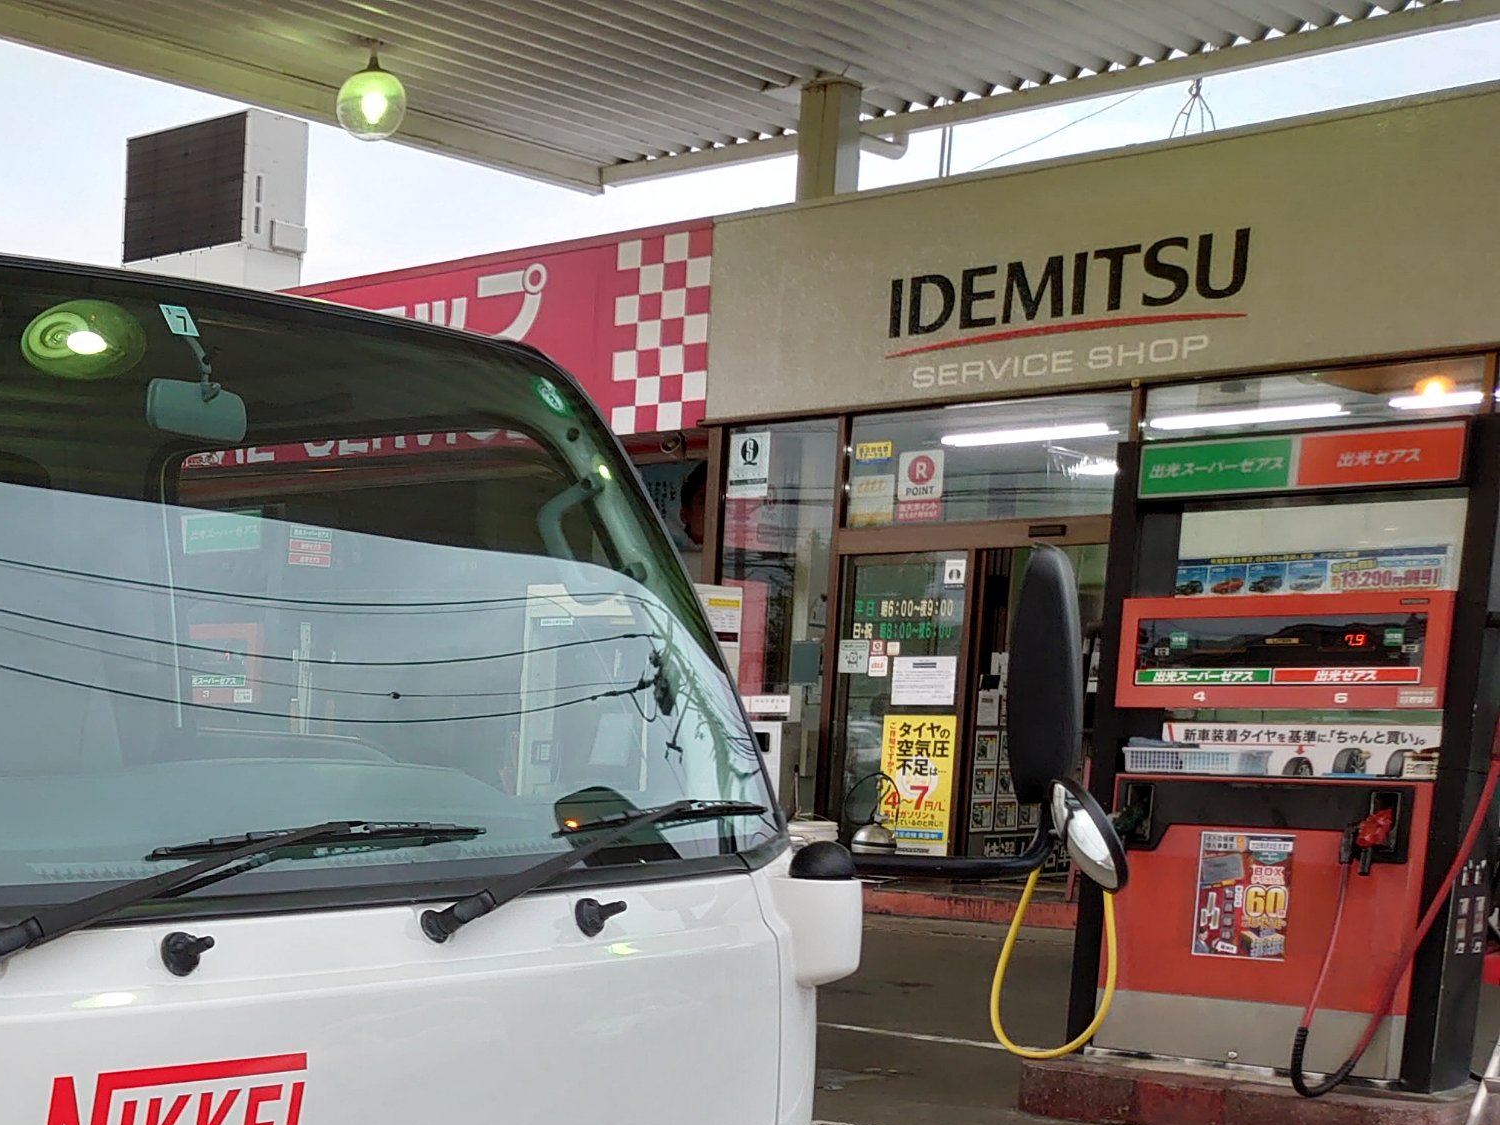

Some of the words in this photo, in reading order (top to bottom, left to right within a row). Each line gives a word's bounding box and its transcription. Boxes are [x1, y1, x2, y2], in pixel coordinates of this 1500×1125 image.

[889, 227, 1251, 339] IDEMITSU
[912, 350, 1075, 389] SERVICE
[1088, 335, 1210, 370] SHOP
[905, 486, 935, 496] POINT
[1153, 671, 1254, 683] 出光スーパーゼアス
[1193, 691, 1206, 702] 4
[1334, 692, 1348, 704] 6
[899, 721, 951, 740] タイヤの
[897, 740, 950, 758] 空気圧
[1254, 867, 1282, 877] BOX
